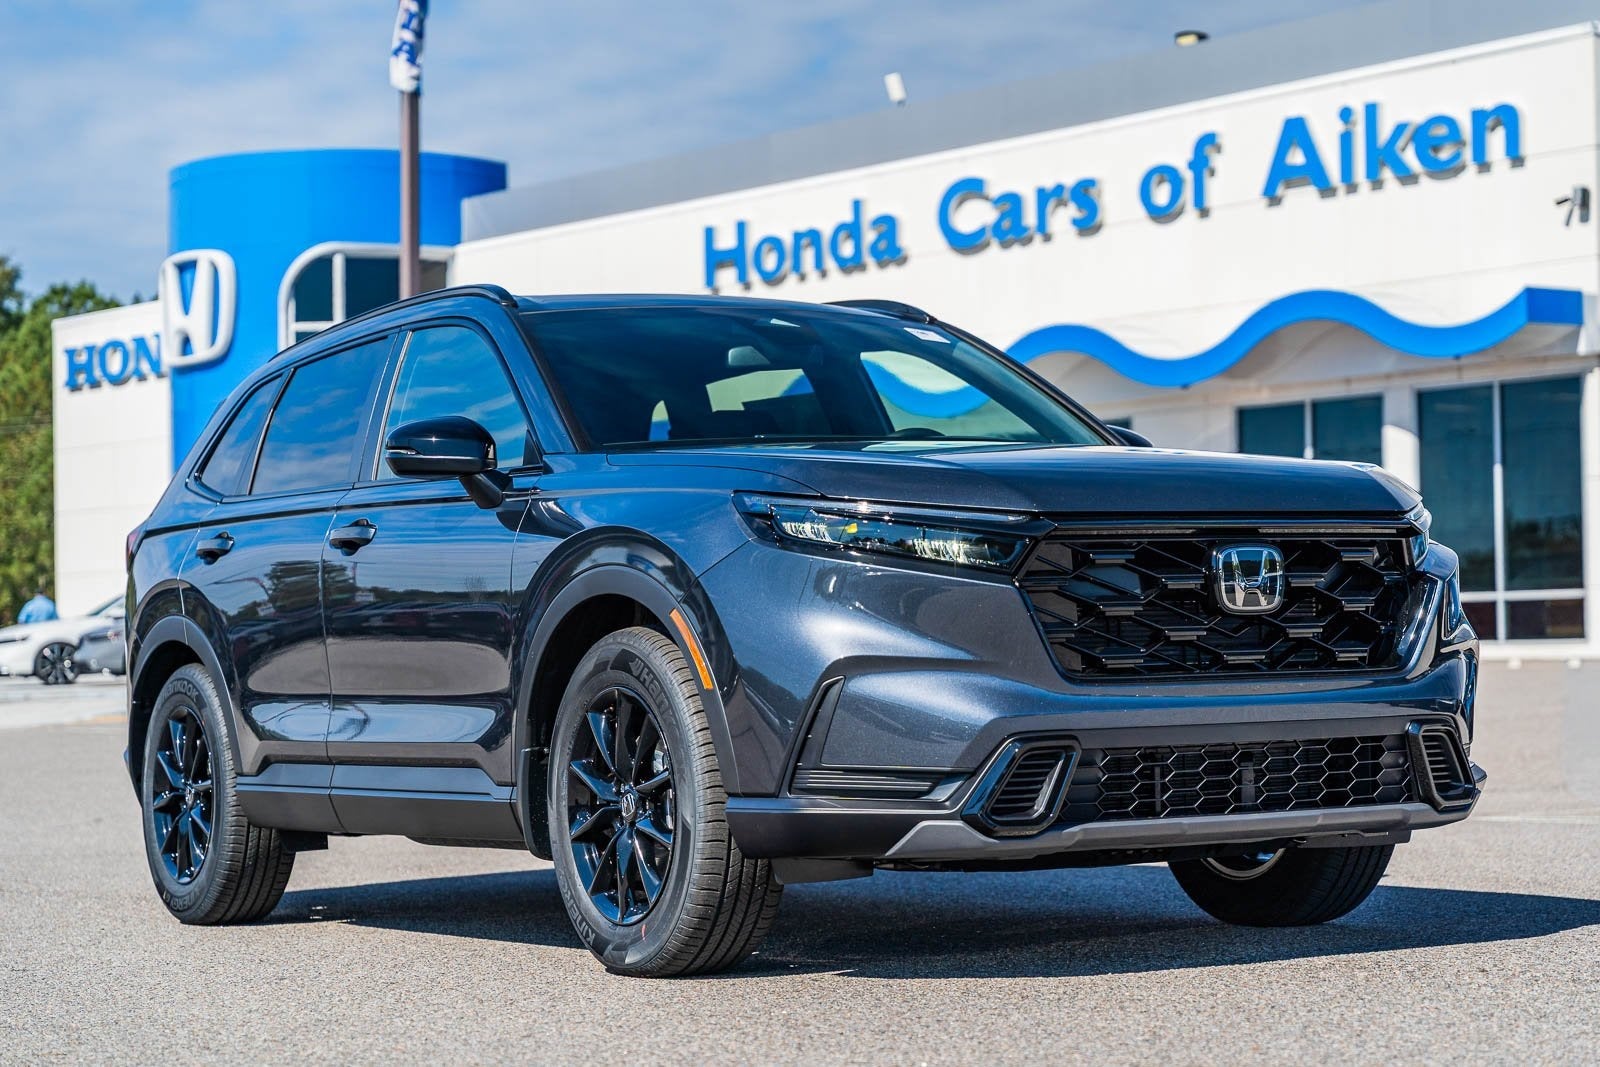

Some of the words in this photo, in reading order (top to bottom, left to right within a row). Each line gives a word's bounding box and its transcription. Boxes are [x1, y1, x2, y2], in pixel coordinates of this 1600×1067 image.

[704, 199, 904, 290] Honda
[938, 177, 1100, 252] Cars
[1139, 132, 1219, 219] of
[1263, 102, 1521, 201] Aiken
